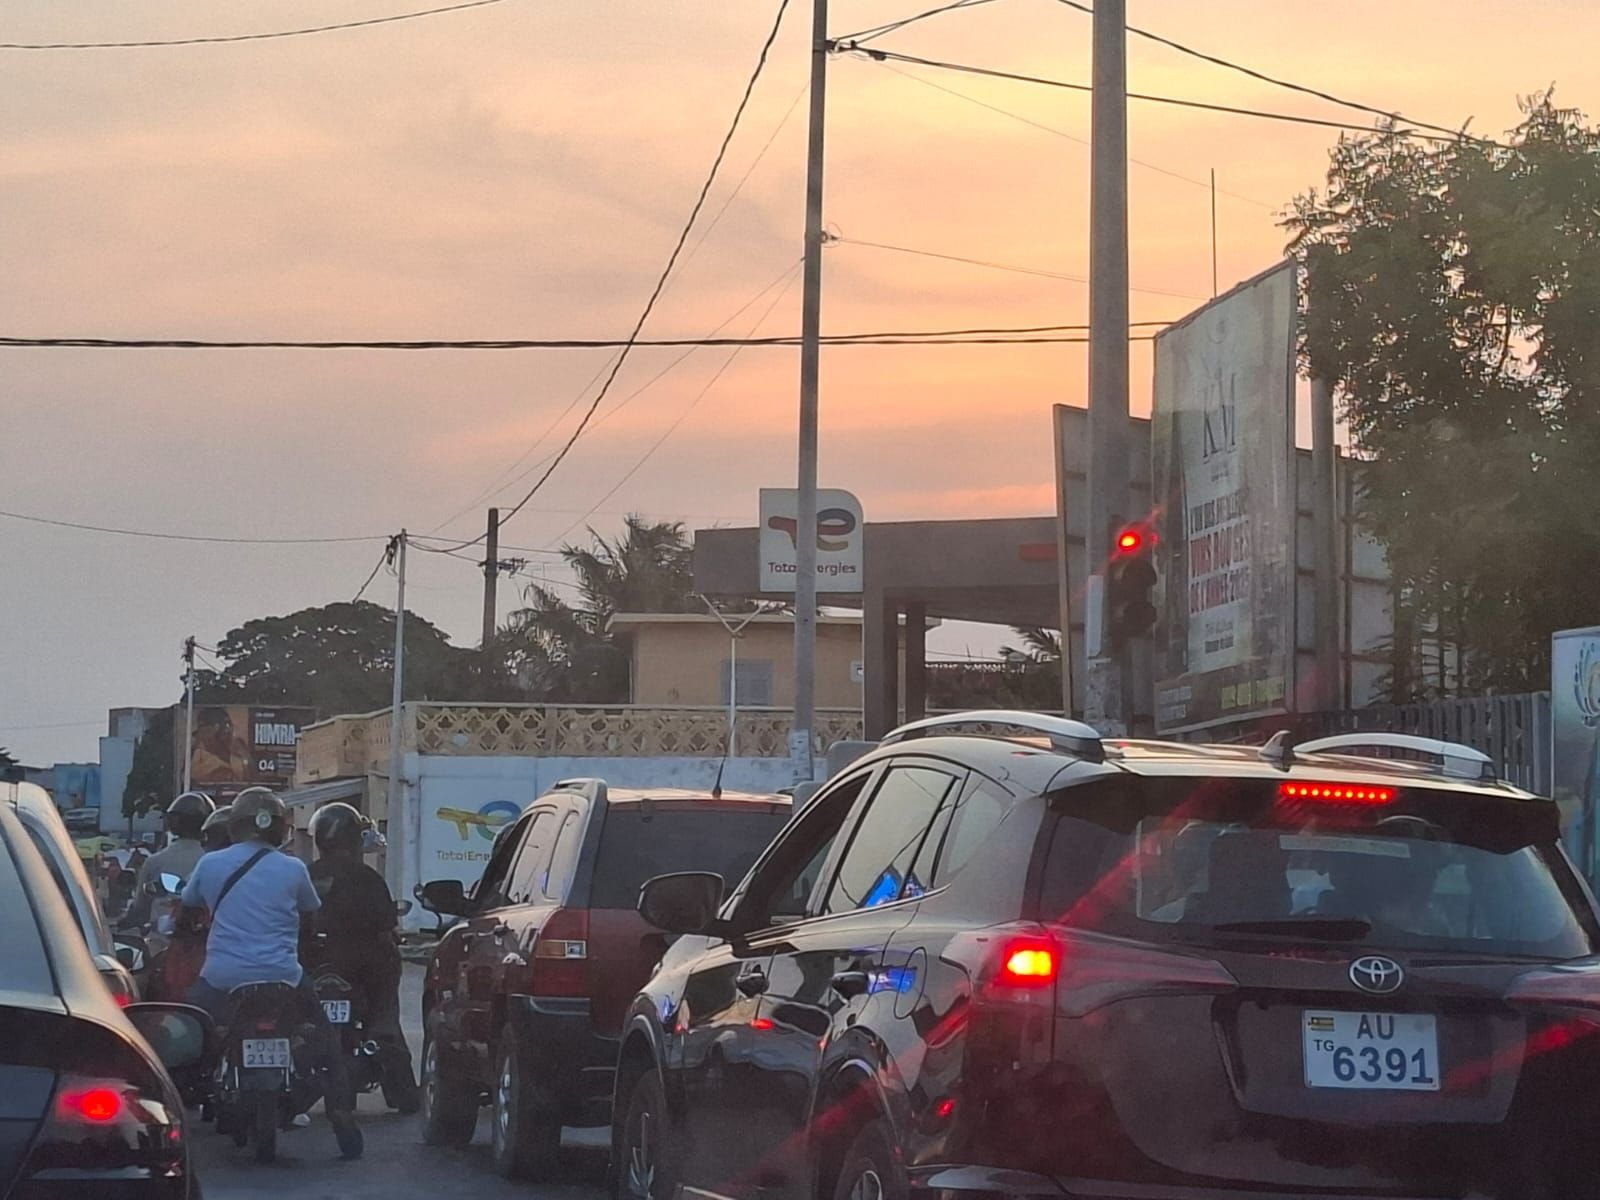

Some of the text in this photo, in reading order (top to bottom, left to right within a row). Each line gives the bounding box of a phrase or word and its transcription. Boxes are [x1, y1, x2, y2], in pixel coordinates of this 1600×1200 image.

[768, 562, 856, 576] Totaergies
[259, 760, 275, 771] 04
[437, 850, 490, 861] TotalEne
[1357, 1014, 1394, 1040] AU
[1313, 1039, 1334, 1051] TG
[1333, 1046, 1433, 1083] 6391
